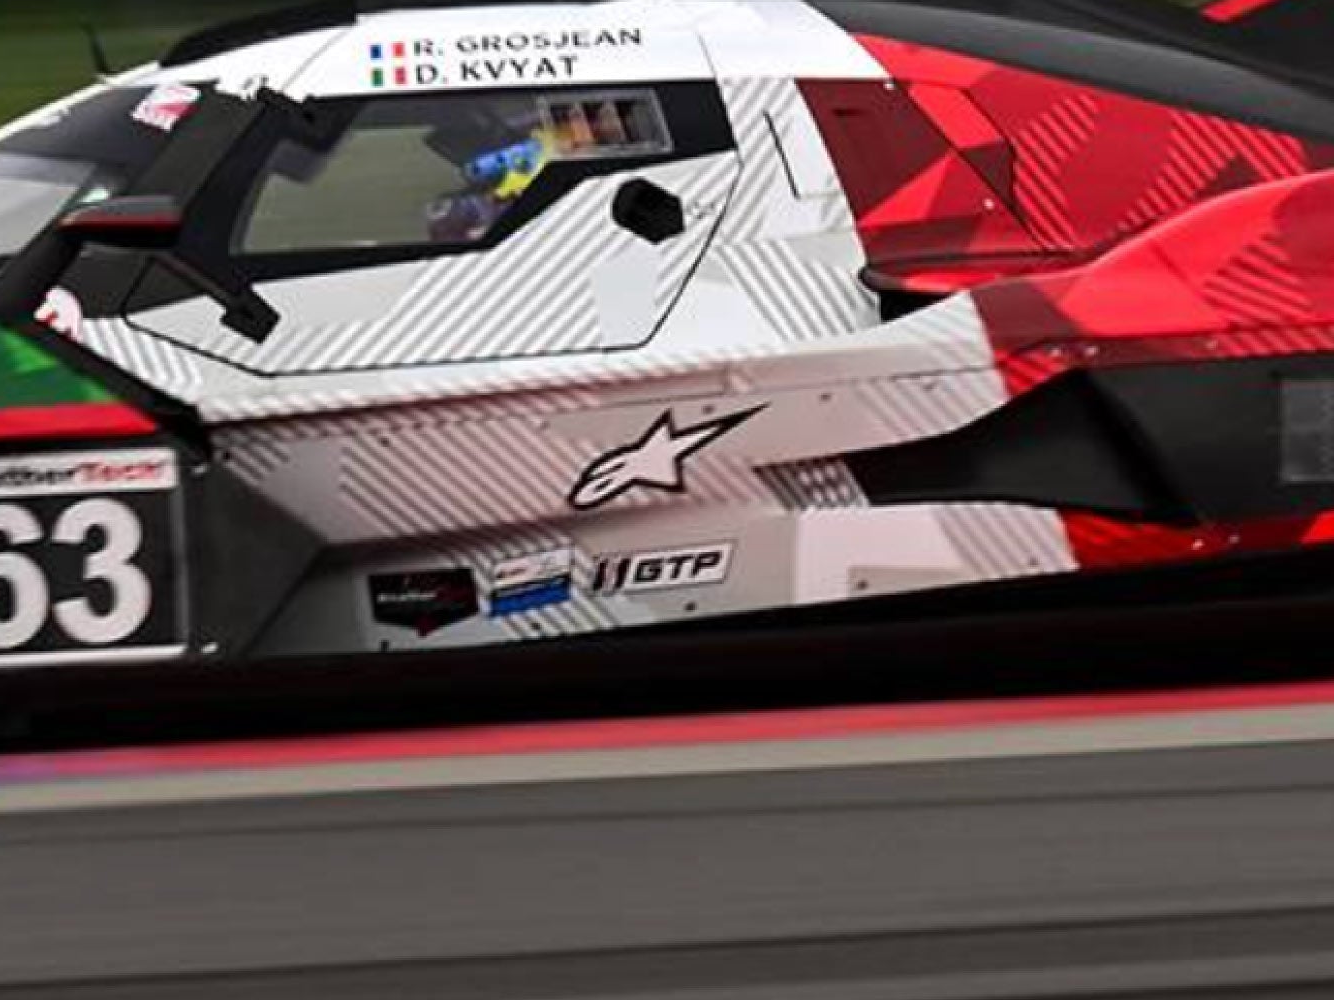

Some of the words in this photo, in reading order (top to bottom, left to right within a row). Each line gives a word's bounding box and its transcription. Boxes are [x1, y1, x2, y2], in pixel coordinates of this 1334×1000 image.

[414, 39, 444, 56] R.
[456, 28, 641, 53] GROSJEAN
[416, 64, 447, 85] D.
[459, 54, 577, 81] KVYAT
[633, 551, 721, 584] GTP
